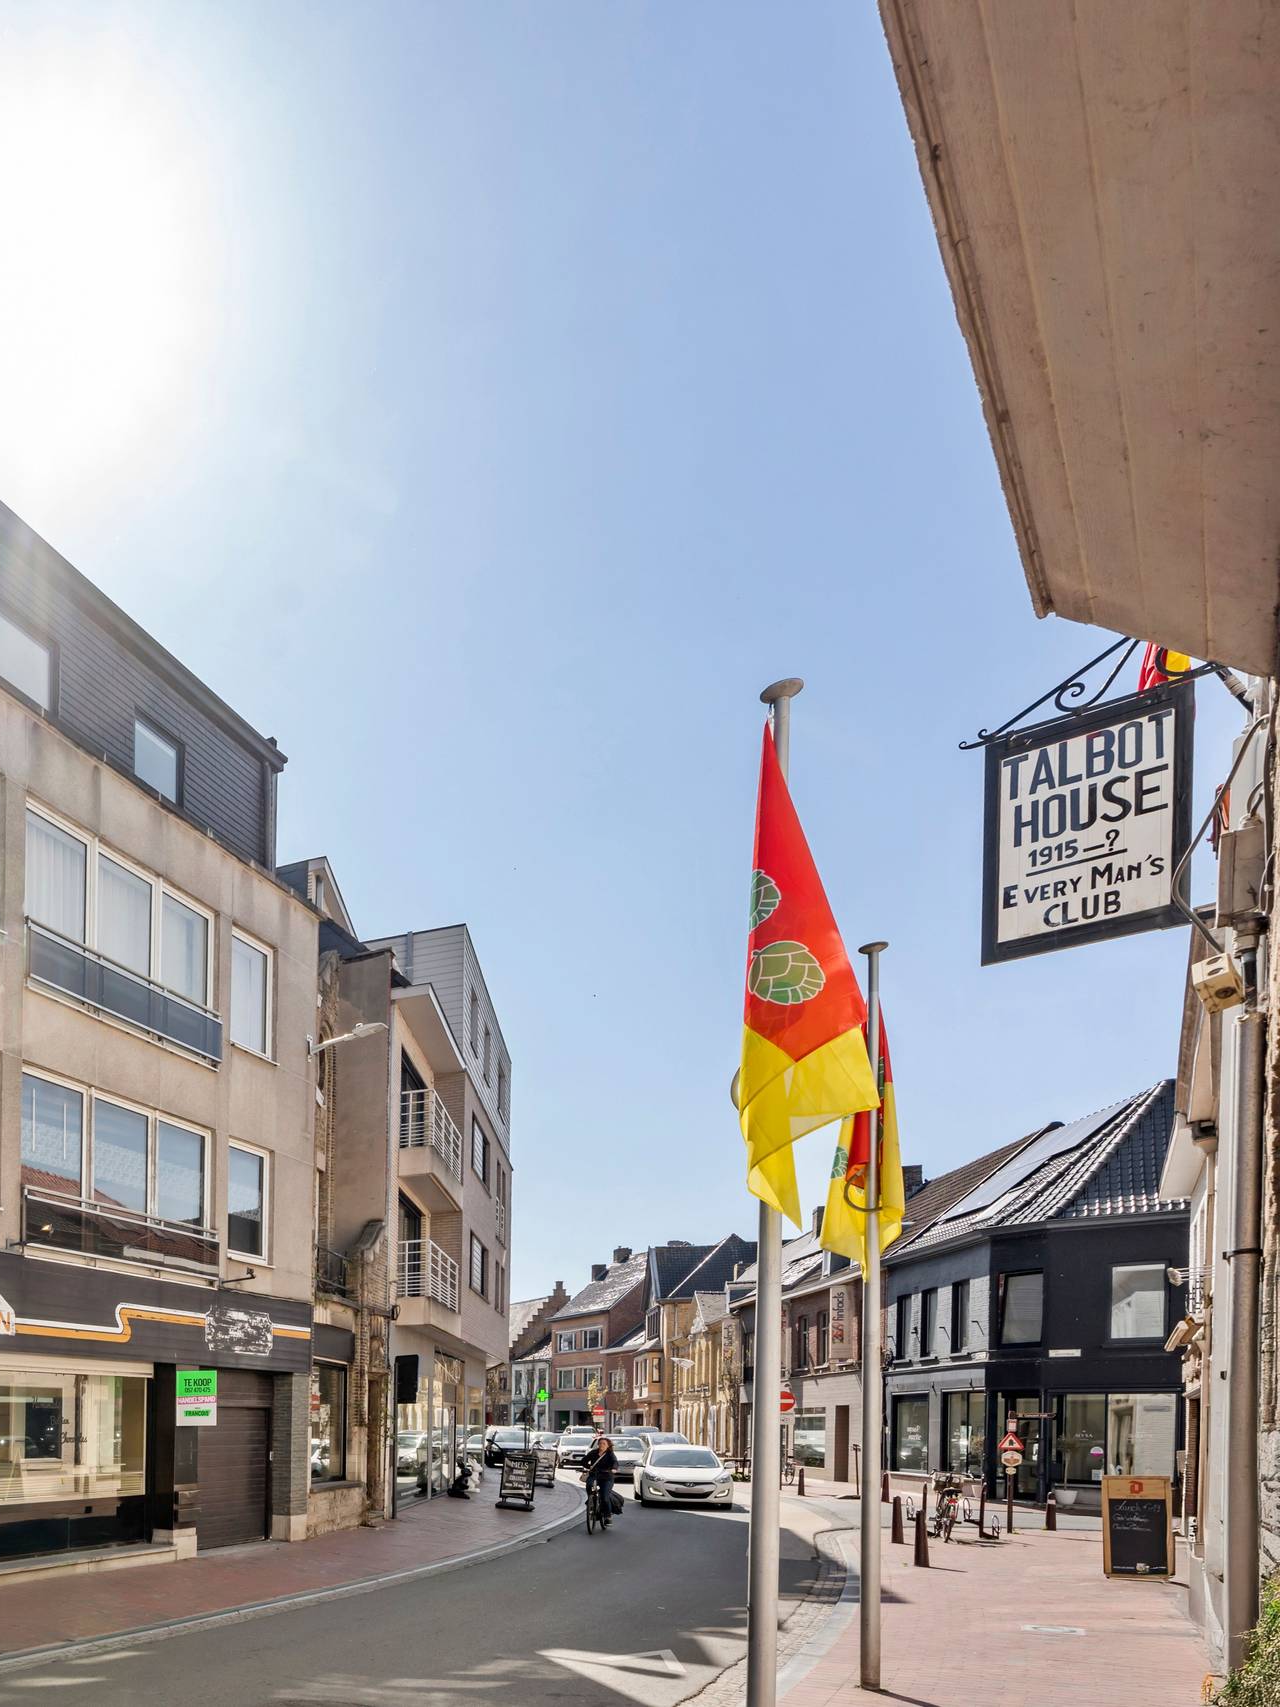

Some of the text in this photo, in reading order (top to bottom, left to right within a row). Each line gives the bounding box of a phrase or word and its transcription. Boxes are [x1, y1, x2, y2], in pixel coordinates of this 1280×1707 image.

[1003, 711, 1172, 800] TALBOT
[1013, 764, 1169, 848] HOUSE
[1043, 890, 1121, 928] CLUB
[184, 1378, 212, 1387] TE KOOP
